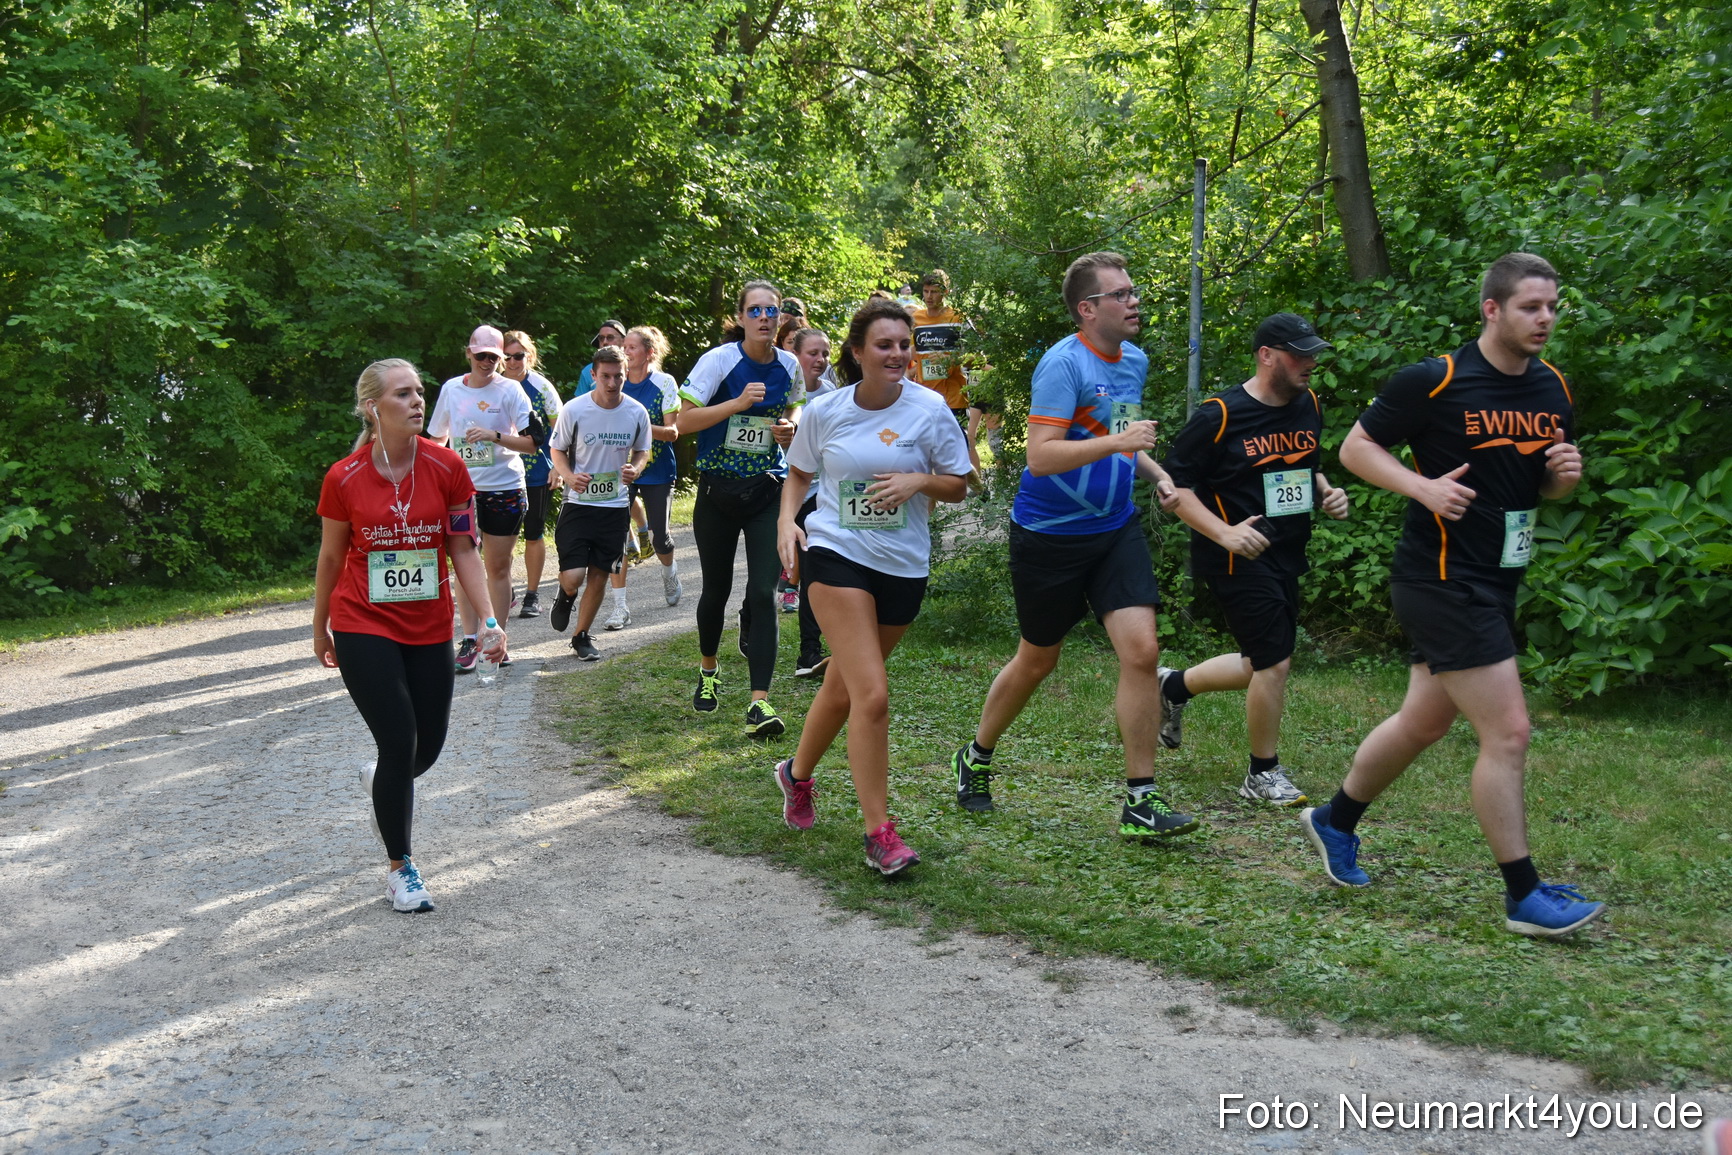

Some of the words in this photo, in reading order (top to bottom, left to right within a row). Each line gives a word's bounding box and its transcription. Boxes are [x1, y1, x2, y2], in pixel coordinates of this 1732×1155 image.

[1465, 411, 1480, 435] BIT
[1480, 410, 1560, 438] WINGS
[598, 432, 631, 440] HAUBNER
[737, 428, 764, 444] 201
[1253, 430, 1317, 455] WINGS
[1243, 439, 1257, 457] BIT
[1276, 486, 1302, 503] 283
[361, 525, 393, 540] Echtes
[394, 519, 441, 536] Handwerk
[372, 539, 400, 547] IMMER
[384, 568, 423, 588] 604
